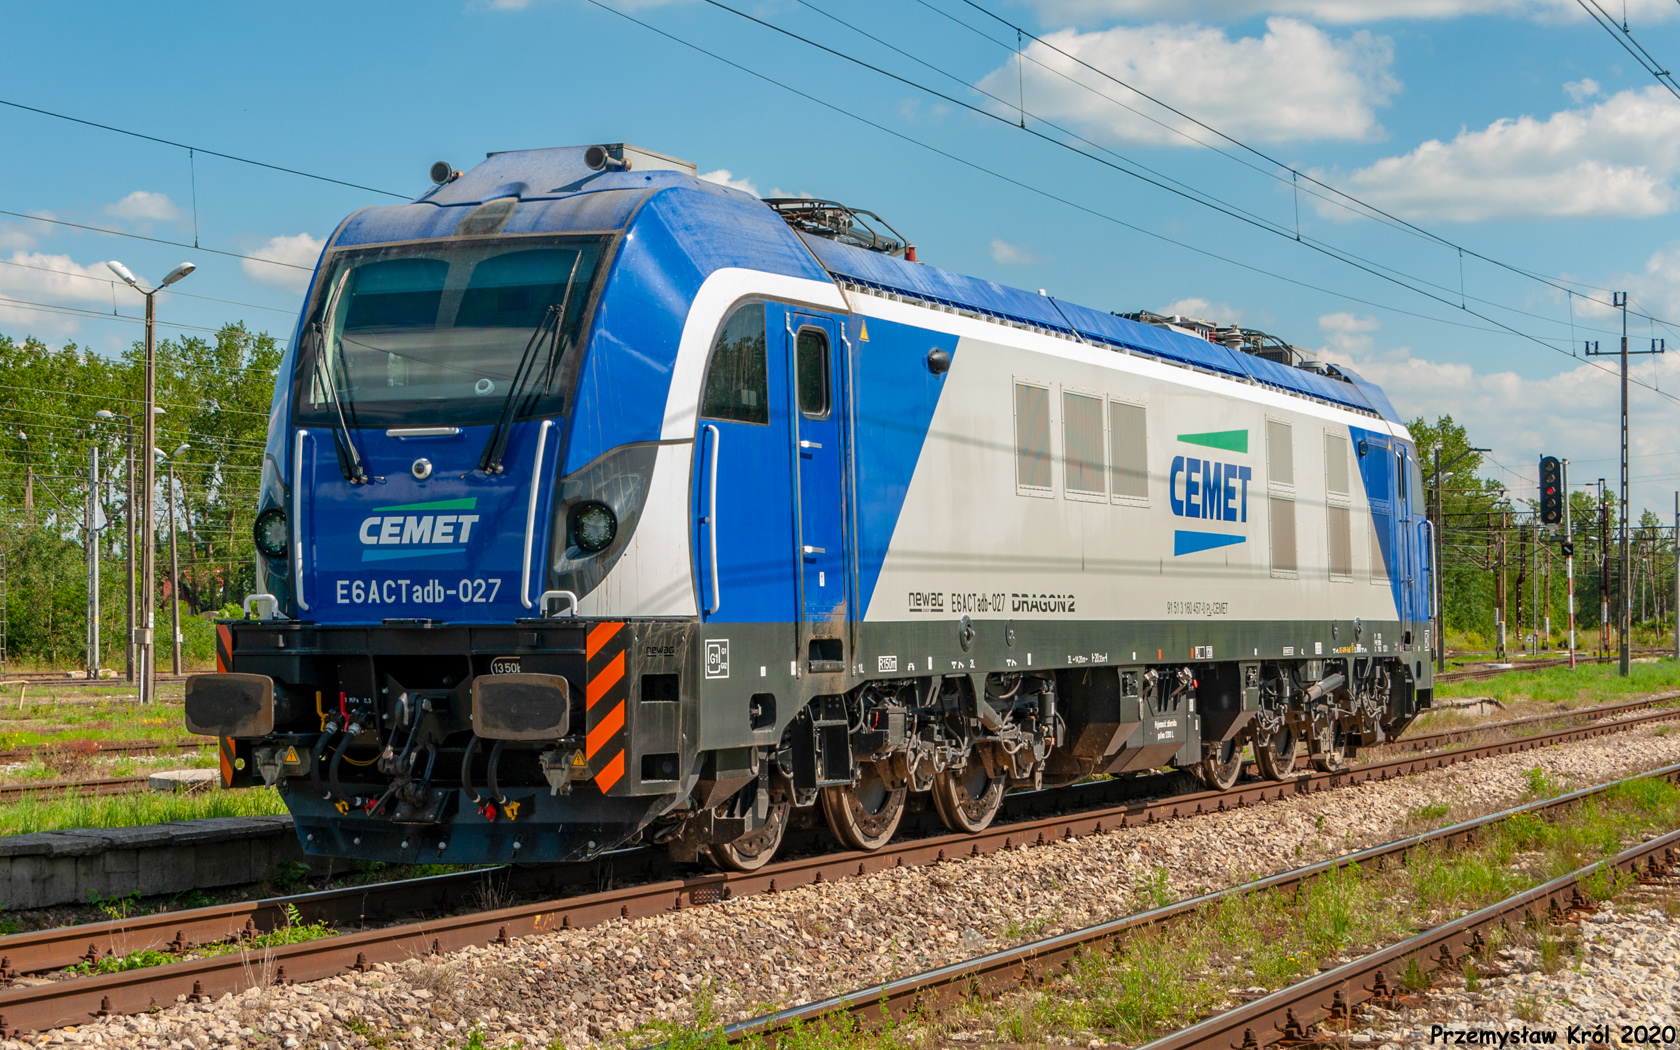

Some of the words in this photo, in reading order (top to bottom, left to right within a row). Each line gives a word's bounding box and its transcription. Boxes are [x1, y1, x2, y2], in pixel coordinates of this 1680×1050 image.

[1170, 456, 1252, 523] CEMET
[359, 515, 480, 545] CEMET
[336, 578, 502, 604] E6ACTadb-027
[908, 592, 943, 607] newag
[951, 593, 1006, 613] E6ACTadb-027
[1011, 593, 1066, 613] DRAGON
[1167, 601, 1172, 615] 91
[1184, 601, 1192, 615] 160
[646, 646, 675, 655] newag
[709, 653, 719, 664] G1
